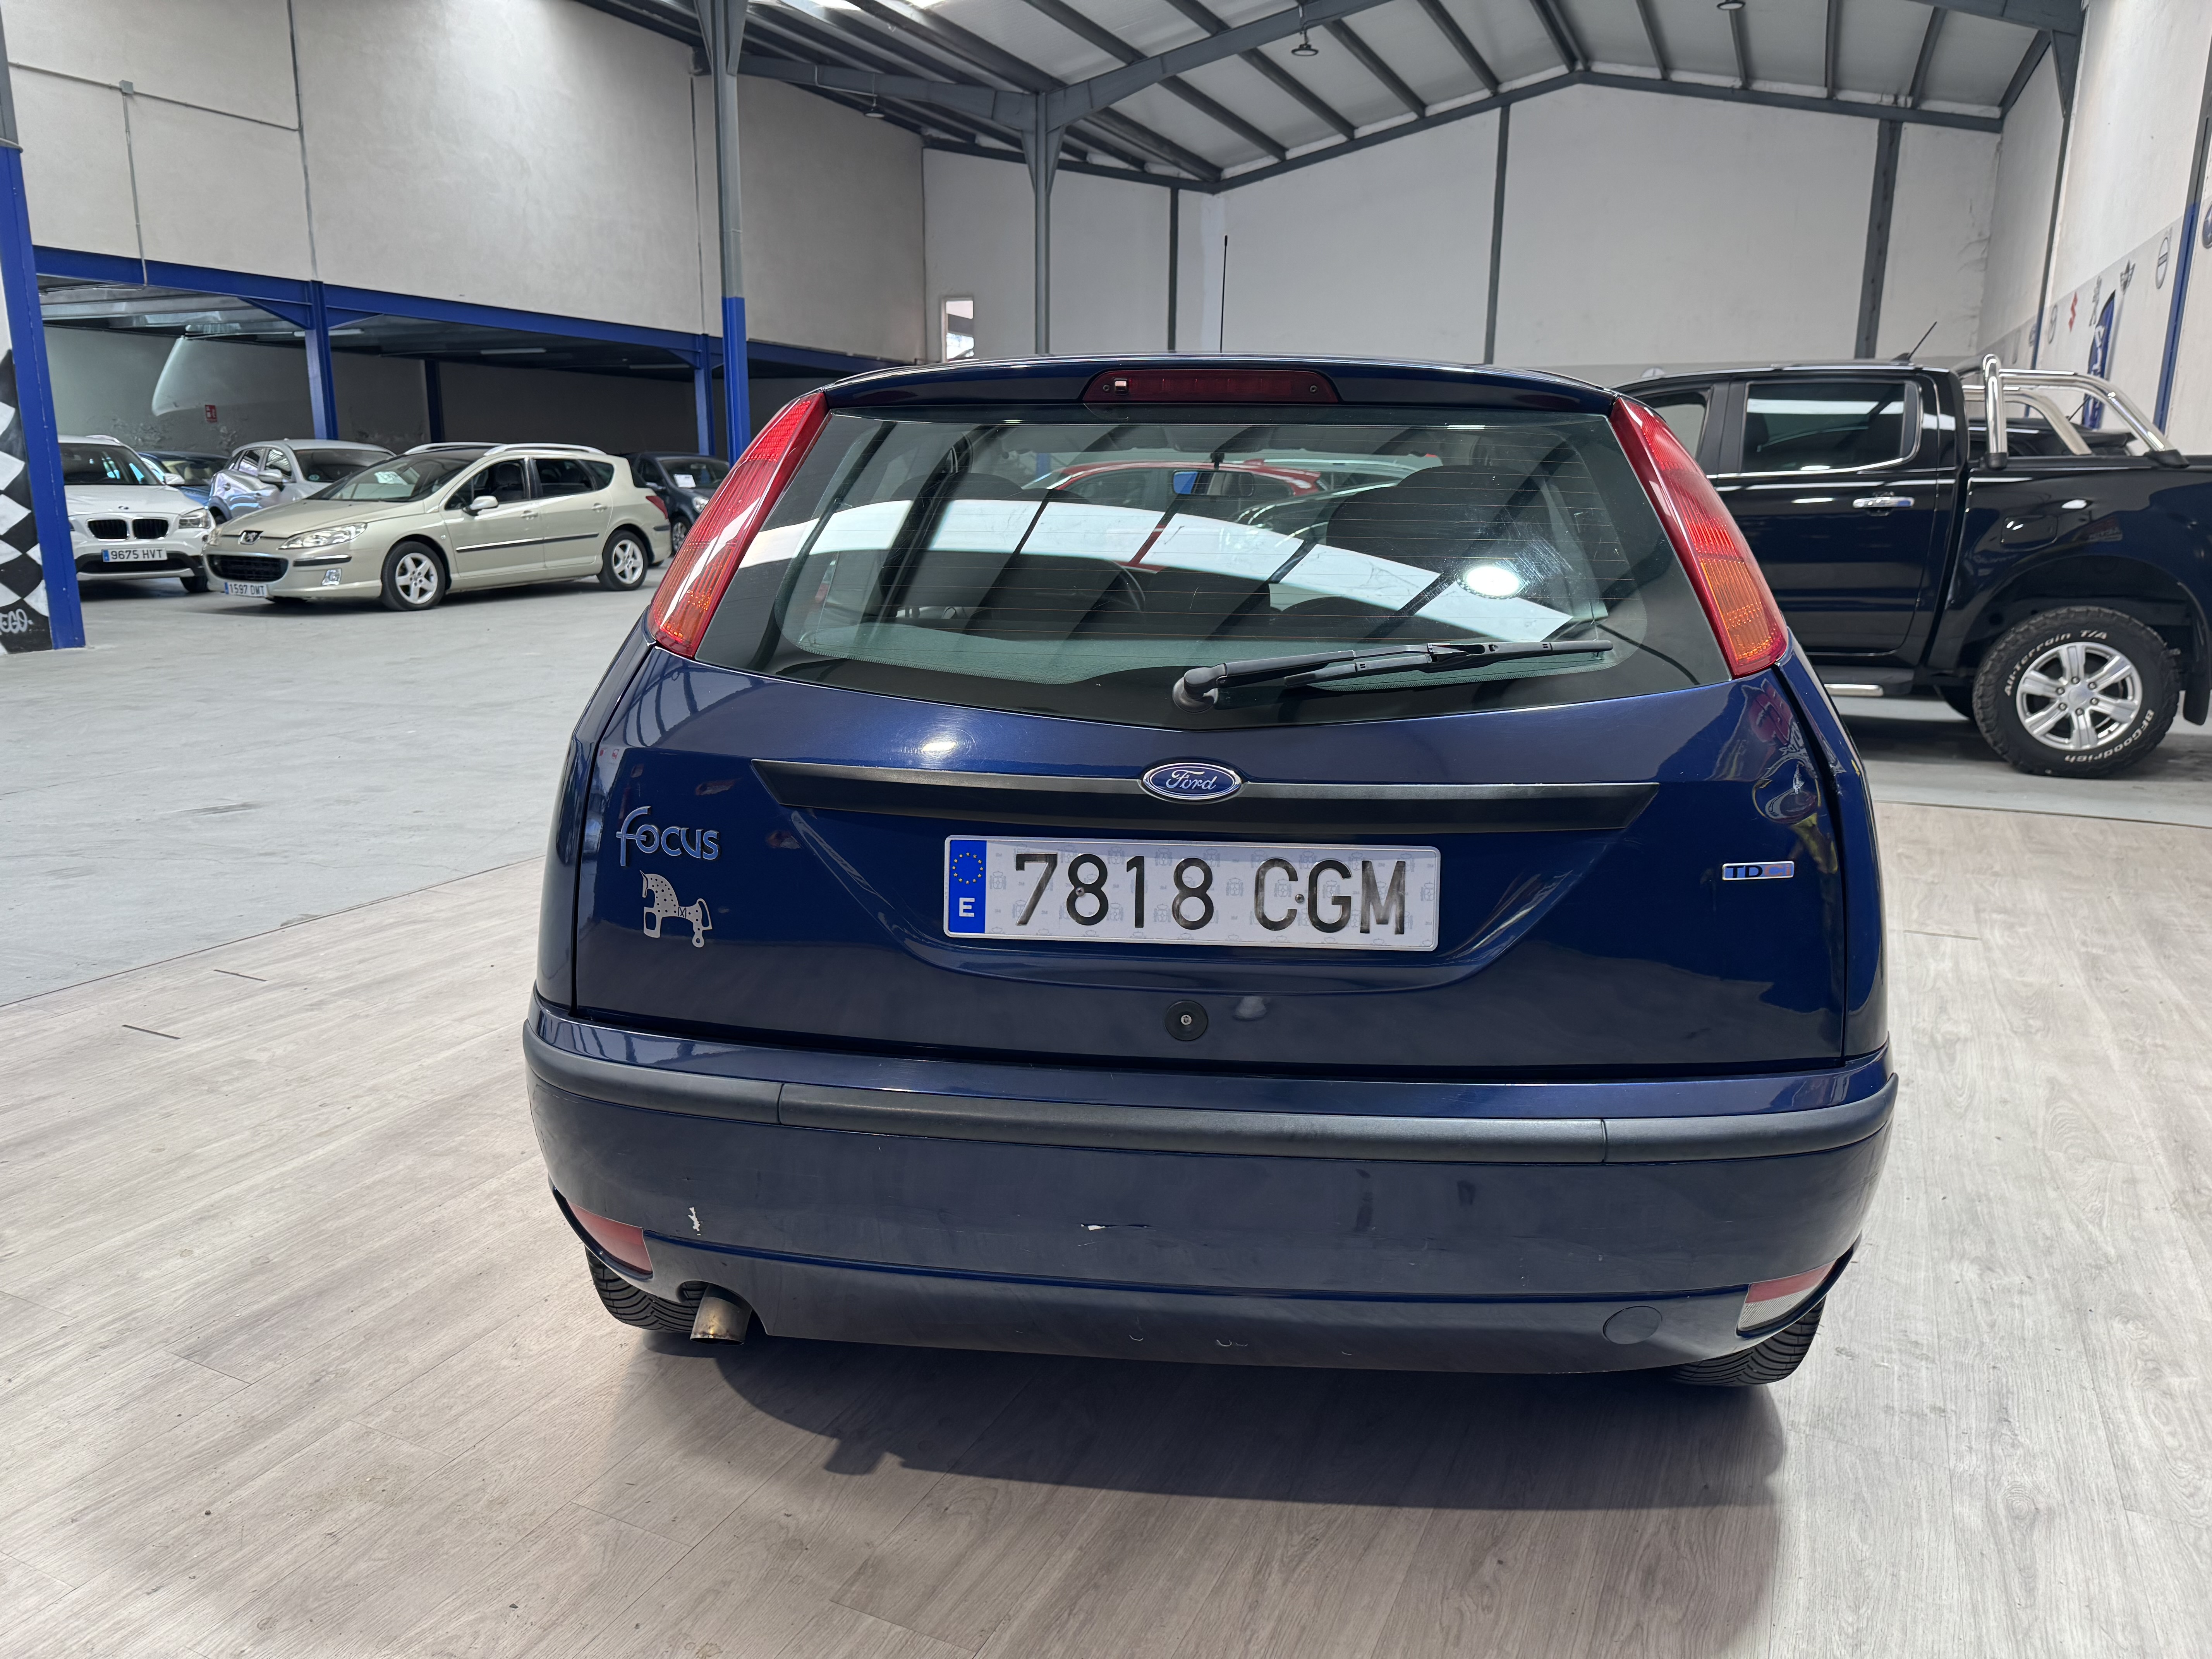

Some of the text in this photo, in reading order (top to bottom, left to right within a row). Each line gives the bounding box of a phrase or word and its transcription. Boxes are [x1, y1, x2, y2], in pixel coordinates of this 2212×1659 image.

[111, 550, 139, 560] 9675
[142, 549, 163, 559] HVT
[229, 584, 264, 595] 1597 DMT
[2004, 630, 2107, 696] All-Terrain T/A
[2064, 709, 2154, 763] BFGoodrich
[1166, 769, 1218, 790] Ford
[1726, 864, 1792, 878] TDCi
[1015, 852, 1406, 935] 7818 CGM
[959, 897, 975, 917] E
